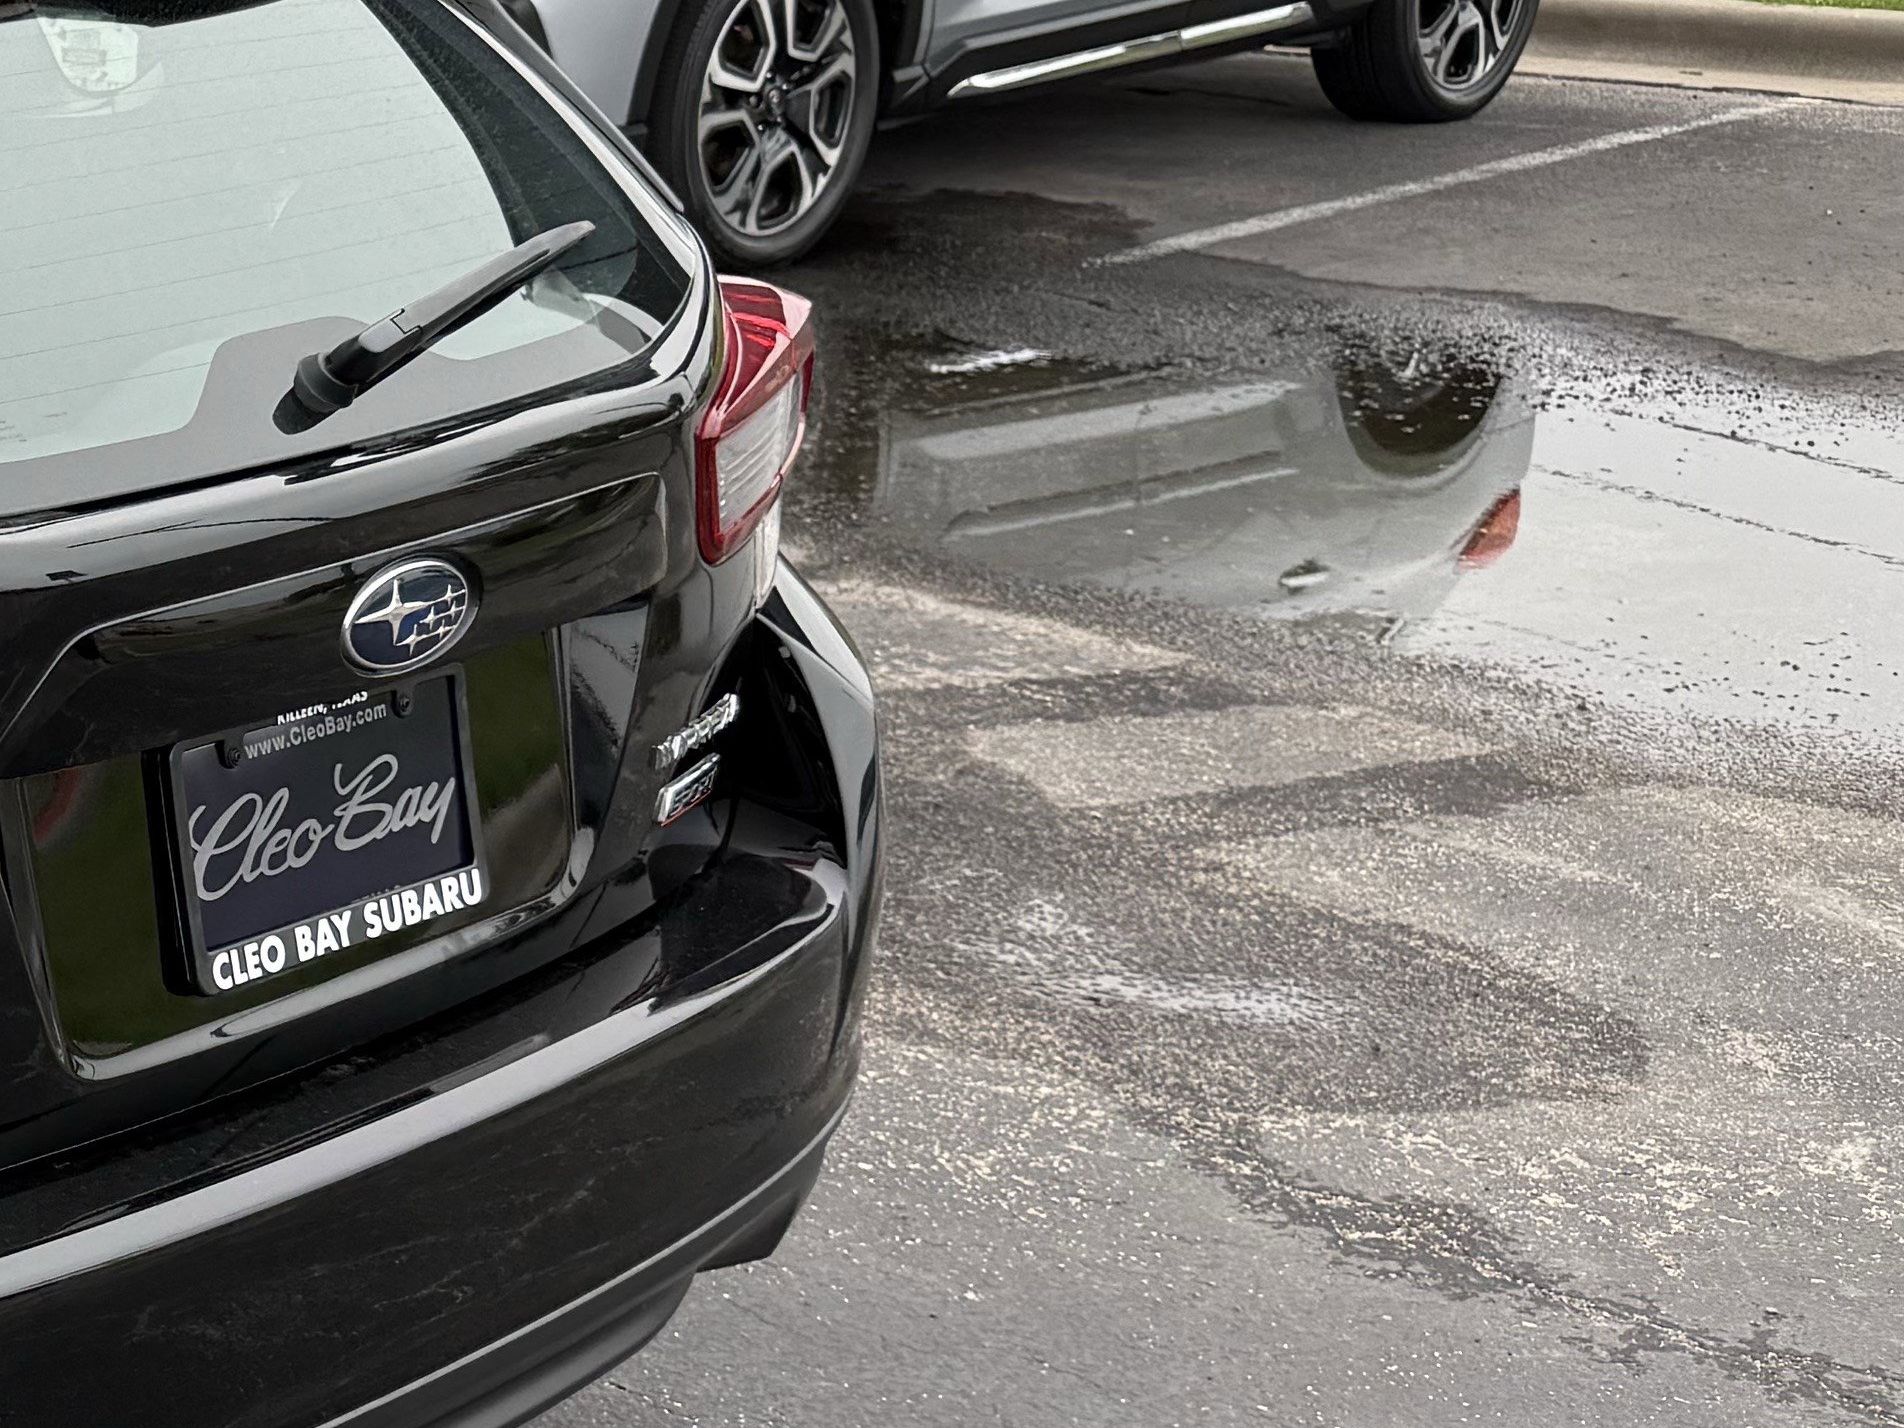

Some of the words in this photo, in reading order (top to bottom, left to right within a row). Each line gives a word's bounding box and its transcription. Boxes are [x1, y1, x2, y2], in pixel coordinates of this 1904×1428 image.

[244, 702, 388, 760] www.CleoBay.com
[189, 786, 336, 902] Cleo
[334, 753, 457, 852] Bay
[212, 934, 287, 991] CLEO
[293, 909, 353, 963] BAY
[362, 868, 484, 940] SUBARU
